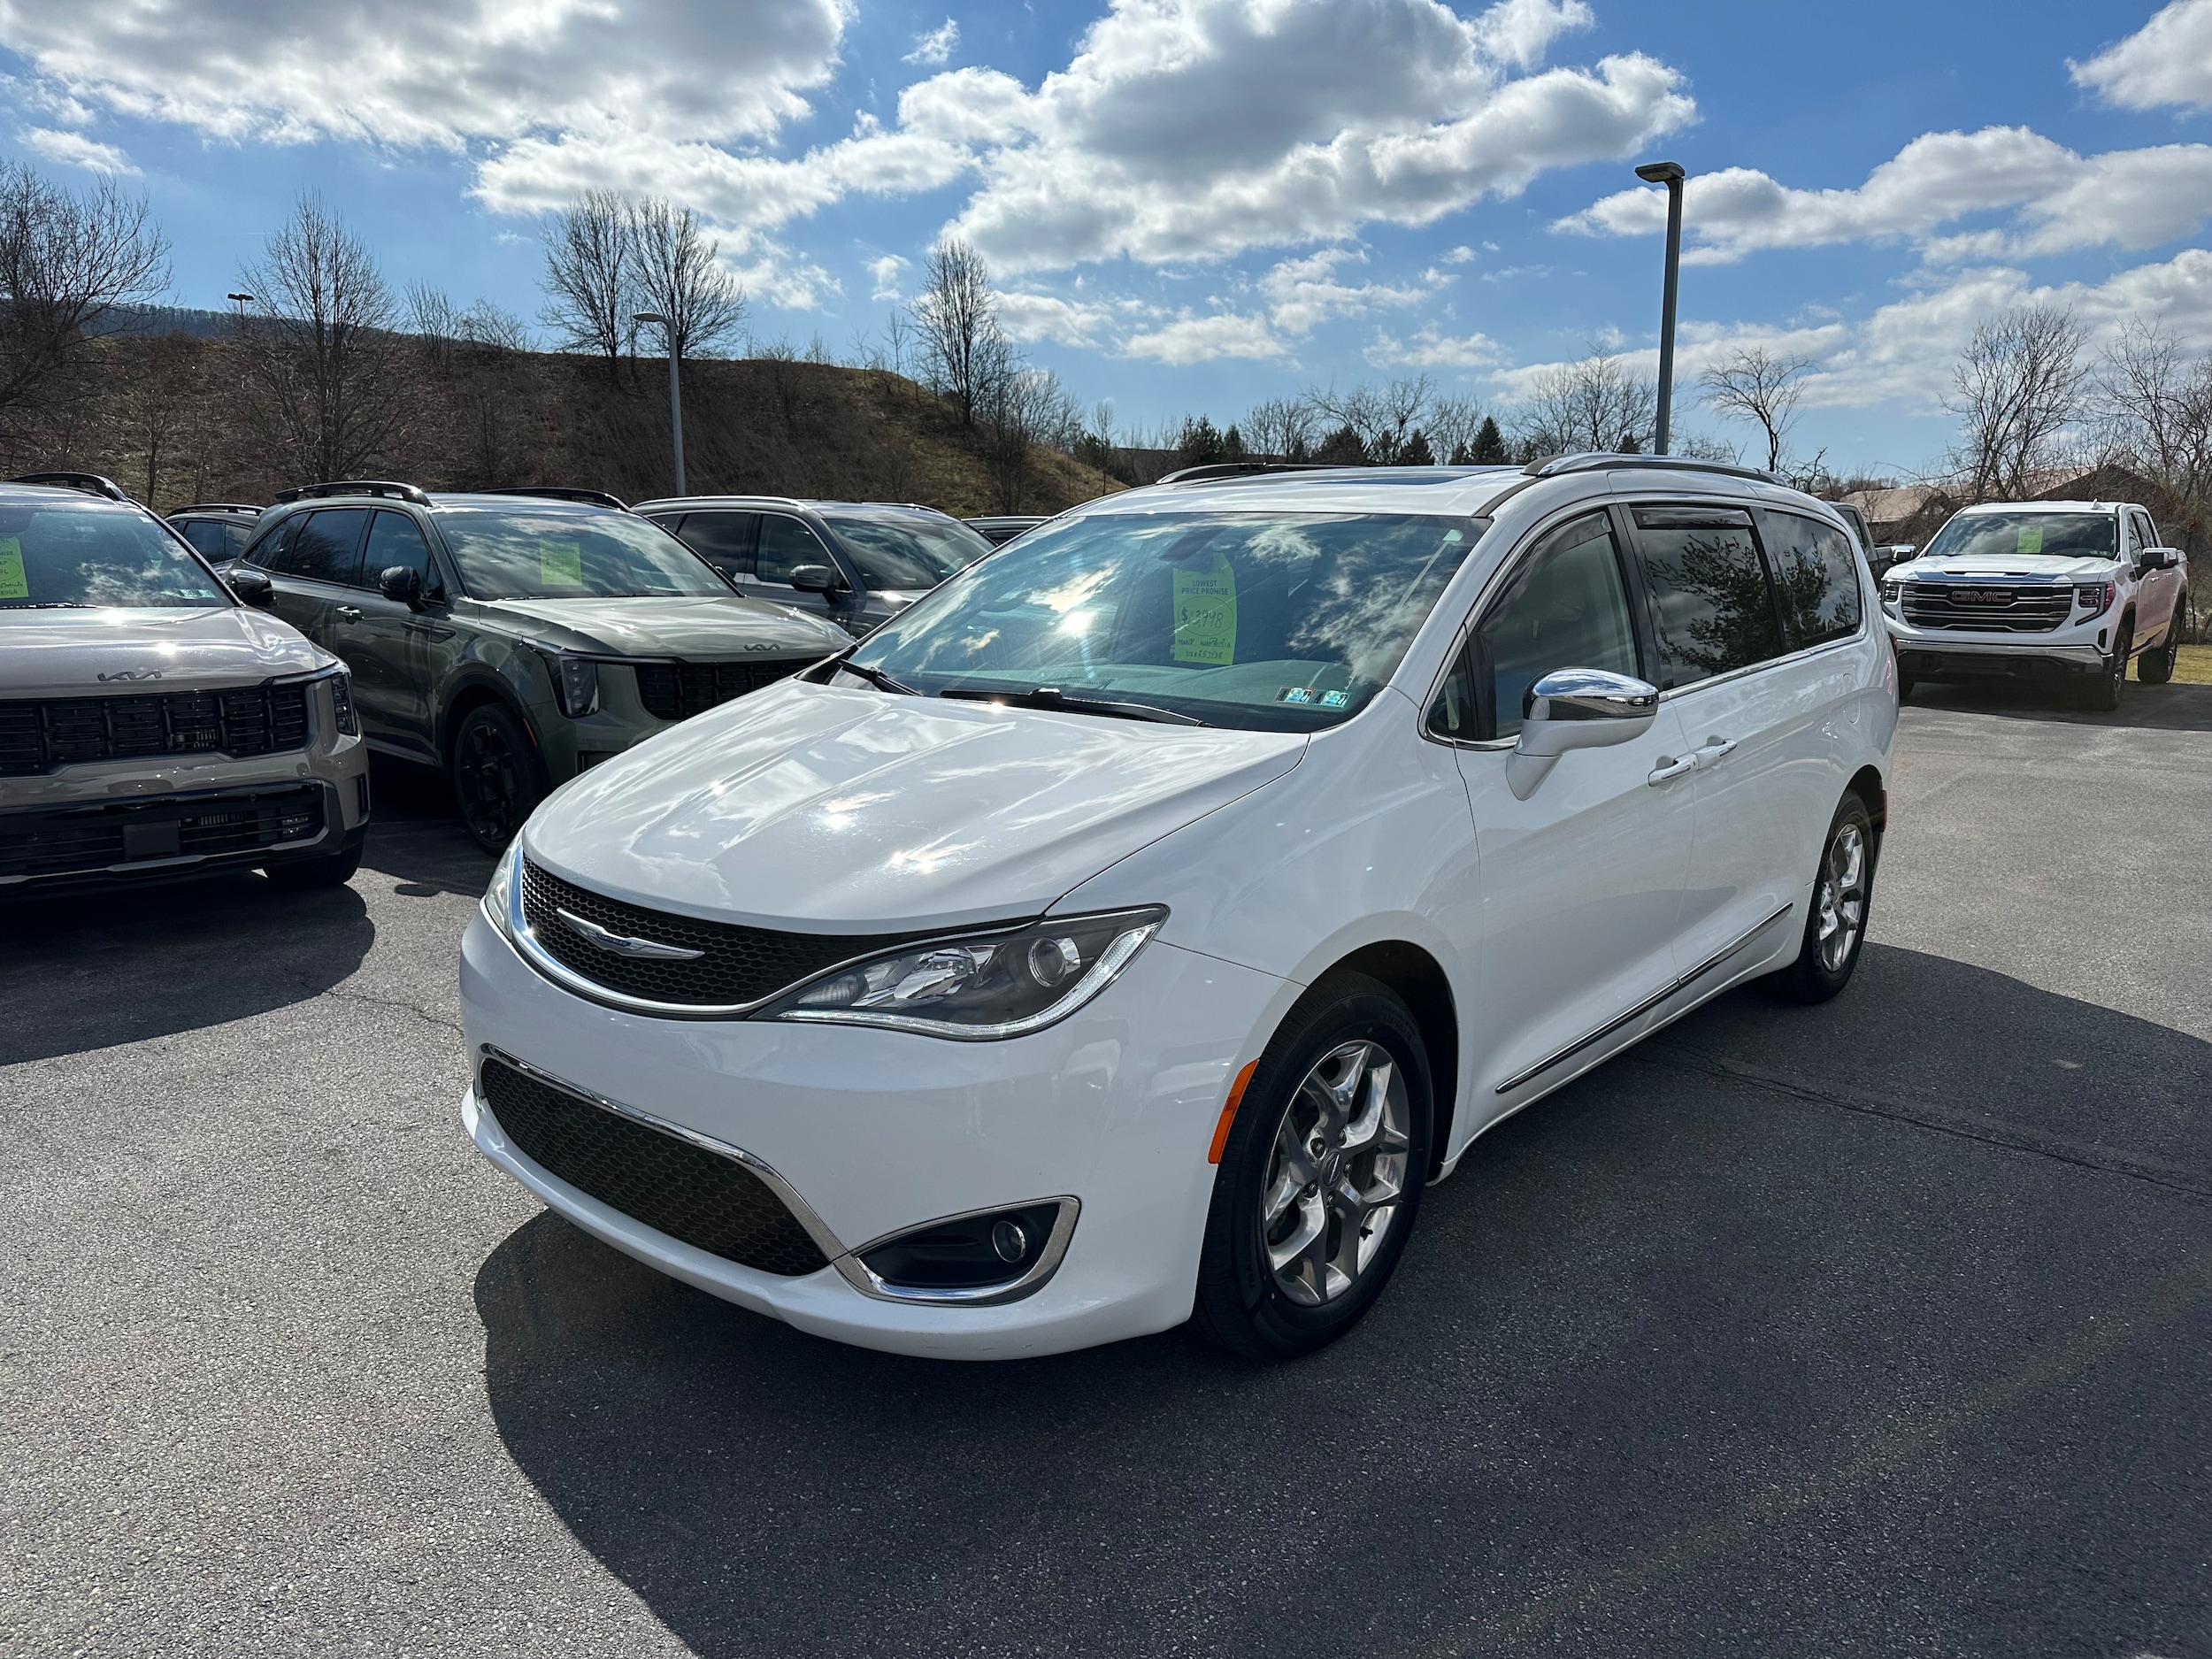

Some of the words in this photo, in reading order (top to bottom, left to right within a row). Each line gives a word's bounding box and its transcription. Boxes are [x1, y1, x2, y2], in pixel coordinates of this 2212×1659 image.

[1952, 590, 2012, 603] GMC
[97, 670, 162, 682] KIA
[1335, 694, 1348, 706] 27
